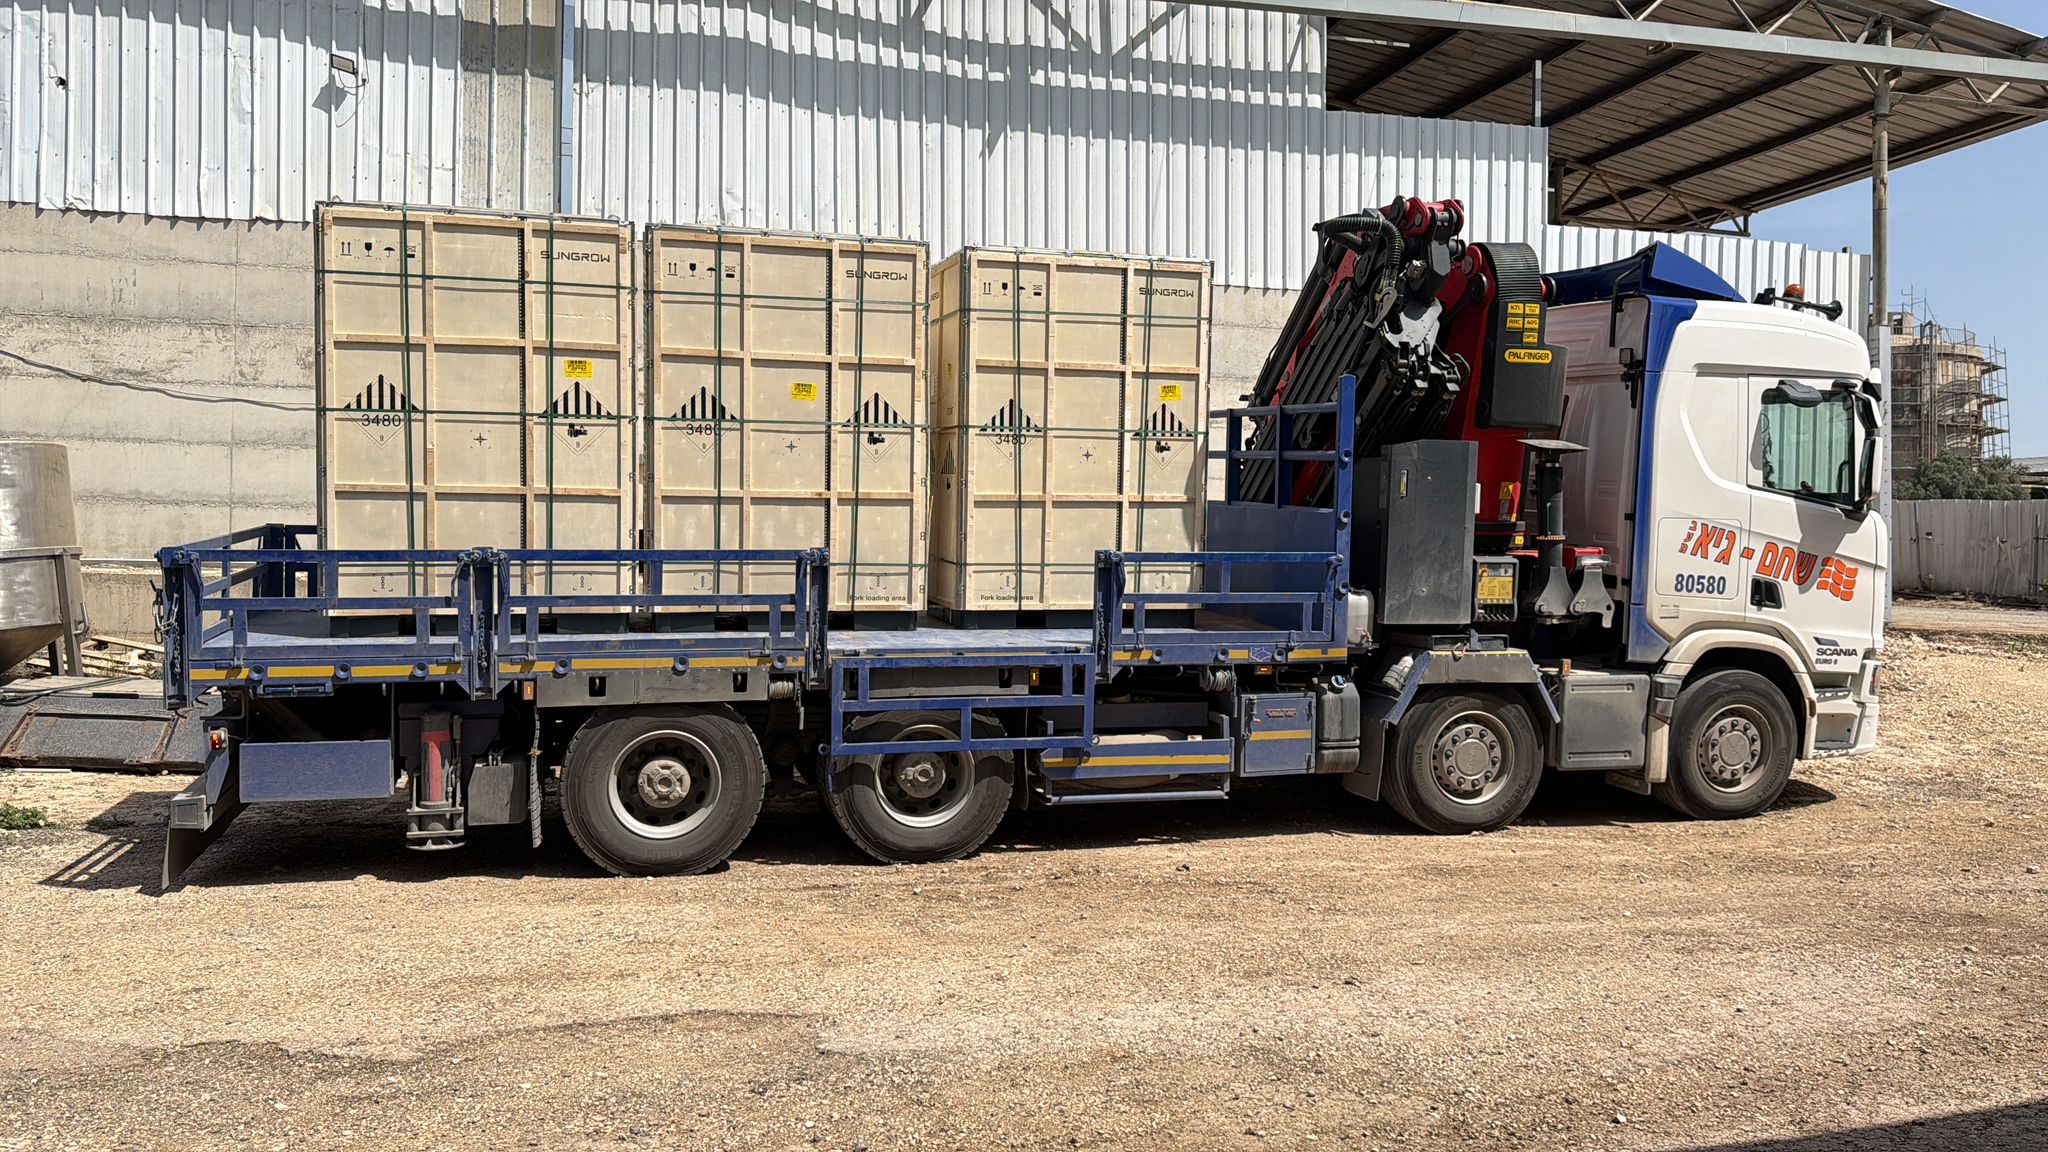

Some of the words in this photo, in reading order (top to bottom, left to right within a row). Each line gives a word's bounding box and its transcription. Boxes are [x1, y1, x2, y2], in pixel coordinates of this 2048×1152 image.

[540, 250, 611, 263] SUNGROW
[846, 269, 908, 281] SUNGROW
[1138, 287, 1194, 298] SUNGROW
[1508, 351, 1550, 361] PALFINGER
[361, 413, 401, 427] 3480
[686, 423, 720, 436] 3480
[995, 434, 1027, 445] 3480
[1690, 523, 1737, 566] גיא
[1755, 541, 1819, 586] שחם
[1674, 573, 1727, 595] 80580
[865, 594, 890, 602] loading
[995, 594, 1018, 602] loading
[1816, 647, 1858, 657] SCANIA
